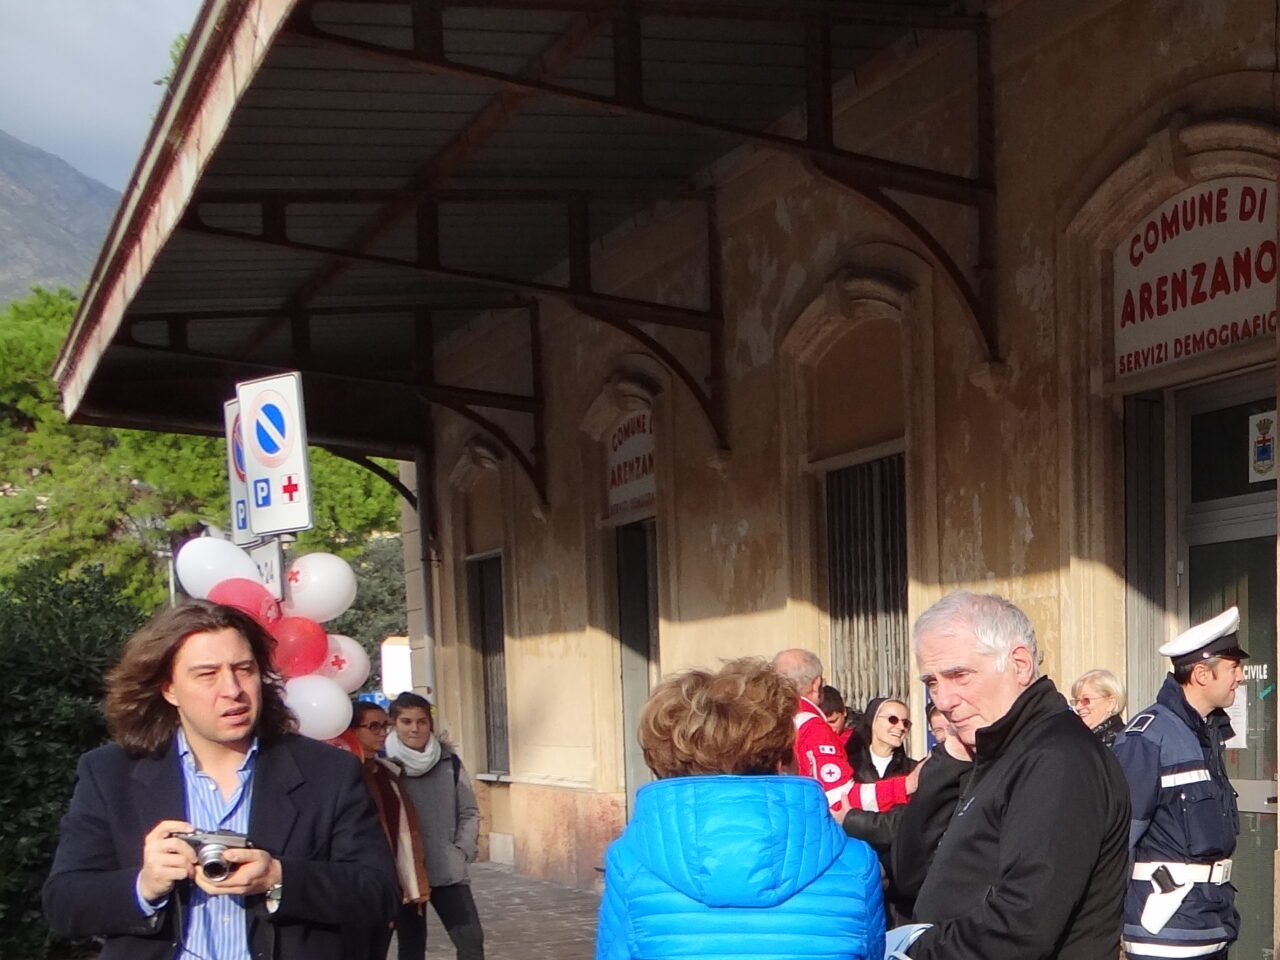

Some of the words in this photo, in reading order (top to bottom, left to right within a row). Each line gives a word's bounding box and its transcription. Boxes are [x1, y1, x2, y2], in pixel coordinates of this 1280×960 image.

[1129, 187, 1229, 267] COMUNE
[1238, 186, 1268, 223] DI
[1120, 240, 1278, 329] ARENZANO
[1119, 343, 1169, 375] SERVIZI
[1173, 310, 1278, 359] DEMOGRAFIC
[611, 413, 646, 452] COMUNE
[609, 452, 655, 490] ARENZAN
[255, 481, 270, 506] P
[238, 502, 247, 528] P
[1243, 664, 1268, 680] CIVILE
